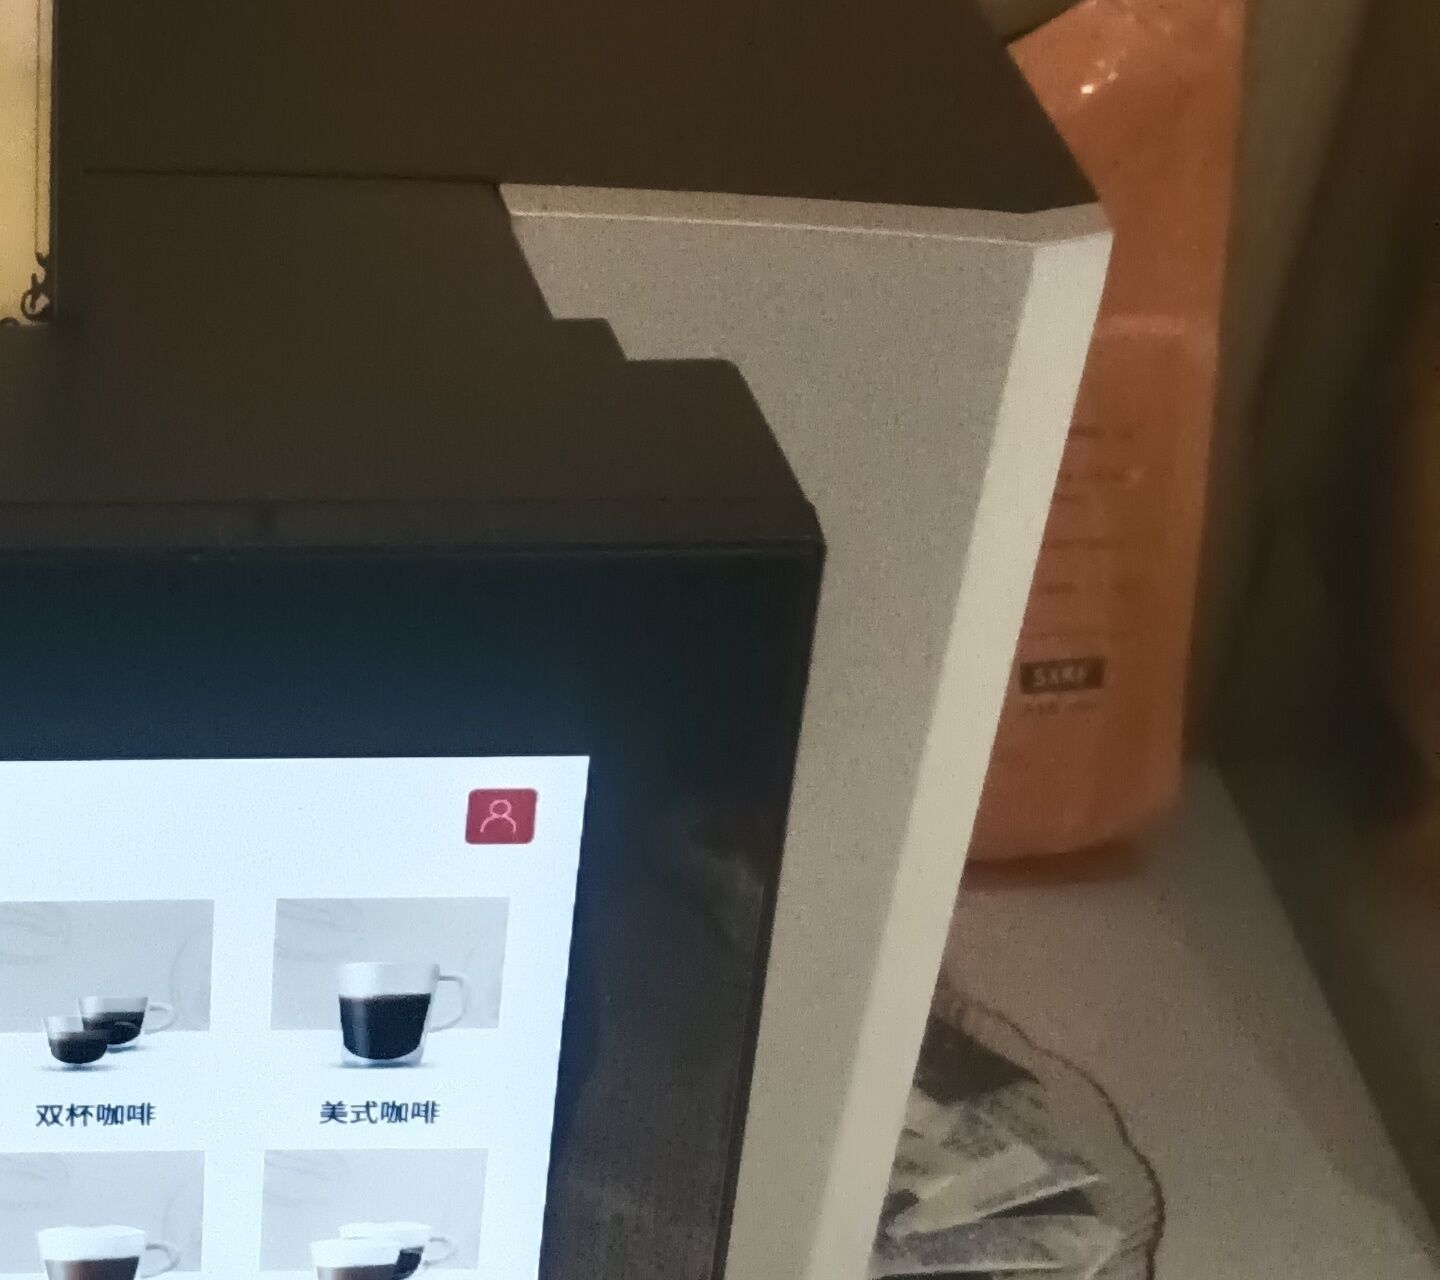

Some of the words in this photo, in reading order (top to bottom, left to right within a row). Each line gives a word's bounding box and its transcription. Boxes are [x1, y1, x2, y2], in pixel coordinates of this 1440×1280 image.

[35, 1102, 156, 1127] 双杯咖啡
[319, 1100, 439, 1125] 美式咖啡
